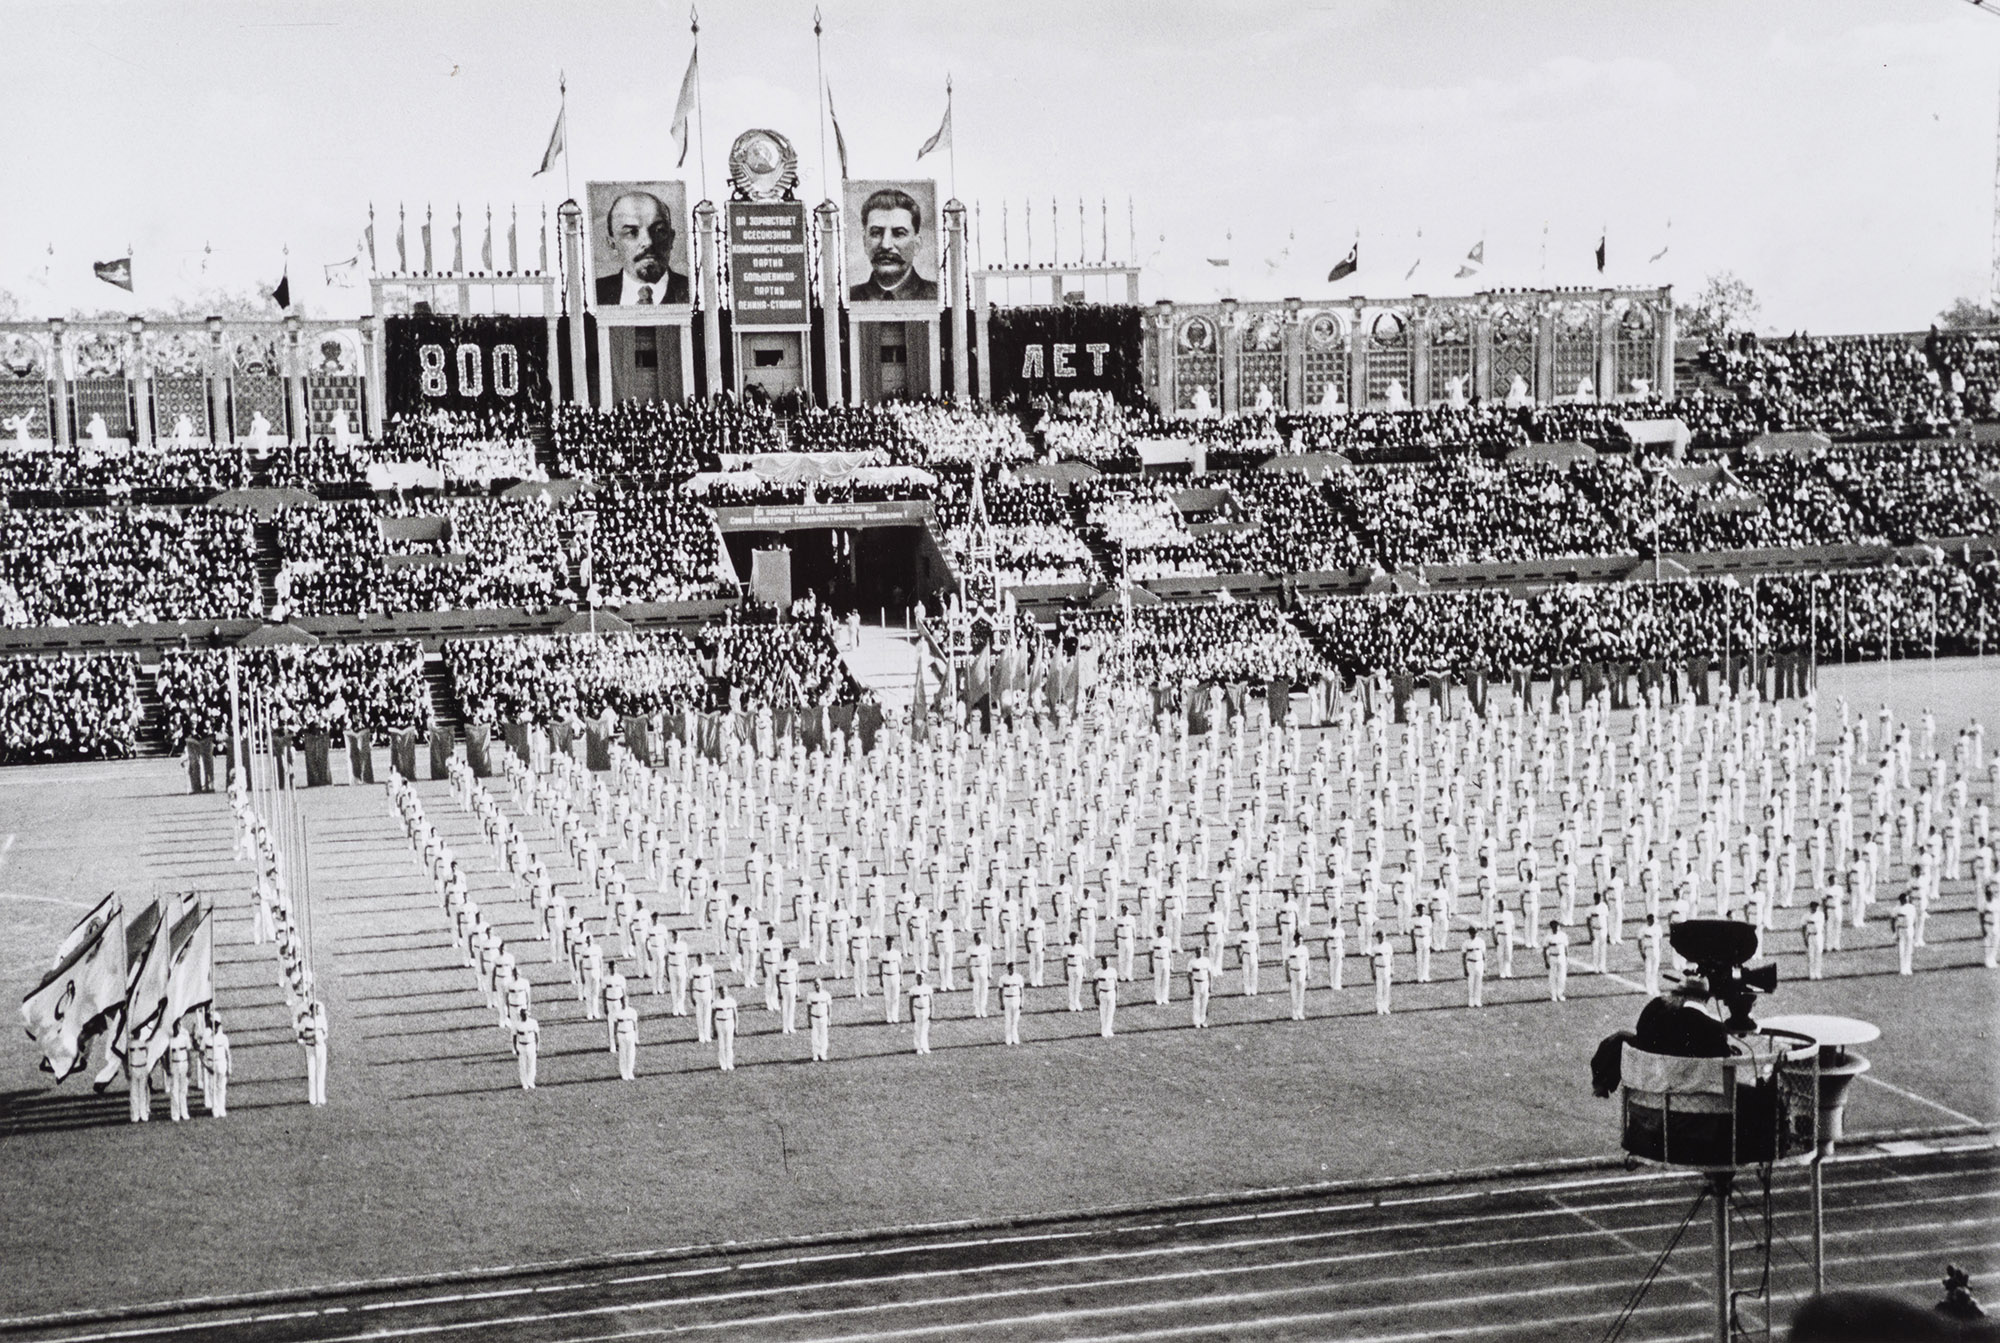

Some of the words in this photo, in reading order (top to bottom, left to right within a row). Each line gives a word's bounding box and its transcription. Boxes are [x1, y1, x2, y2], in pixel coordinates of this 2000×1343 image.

[743, 230, 791, 240] ВСЕСОЮЗНАЯ
[752, 258, 783, 268] ПАРТИЯ
[754, 286, 785, 296] ПАРТИЯ
[1022, 342, 1110, 379] ЛЕТ
[419, 343, 519, 397] 800
